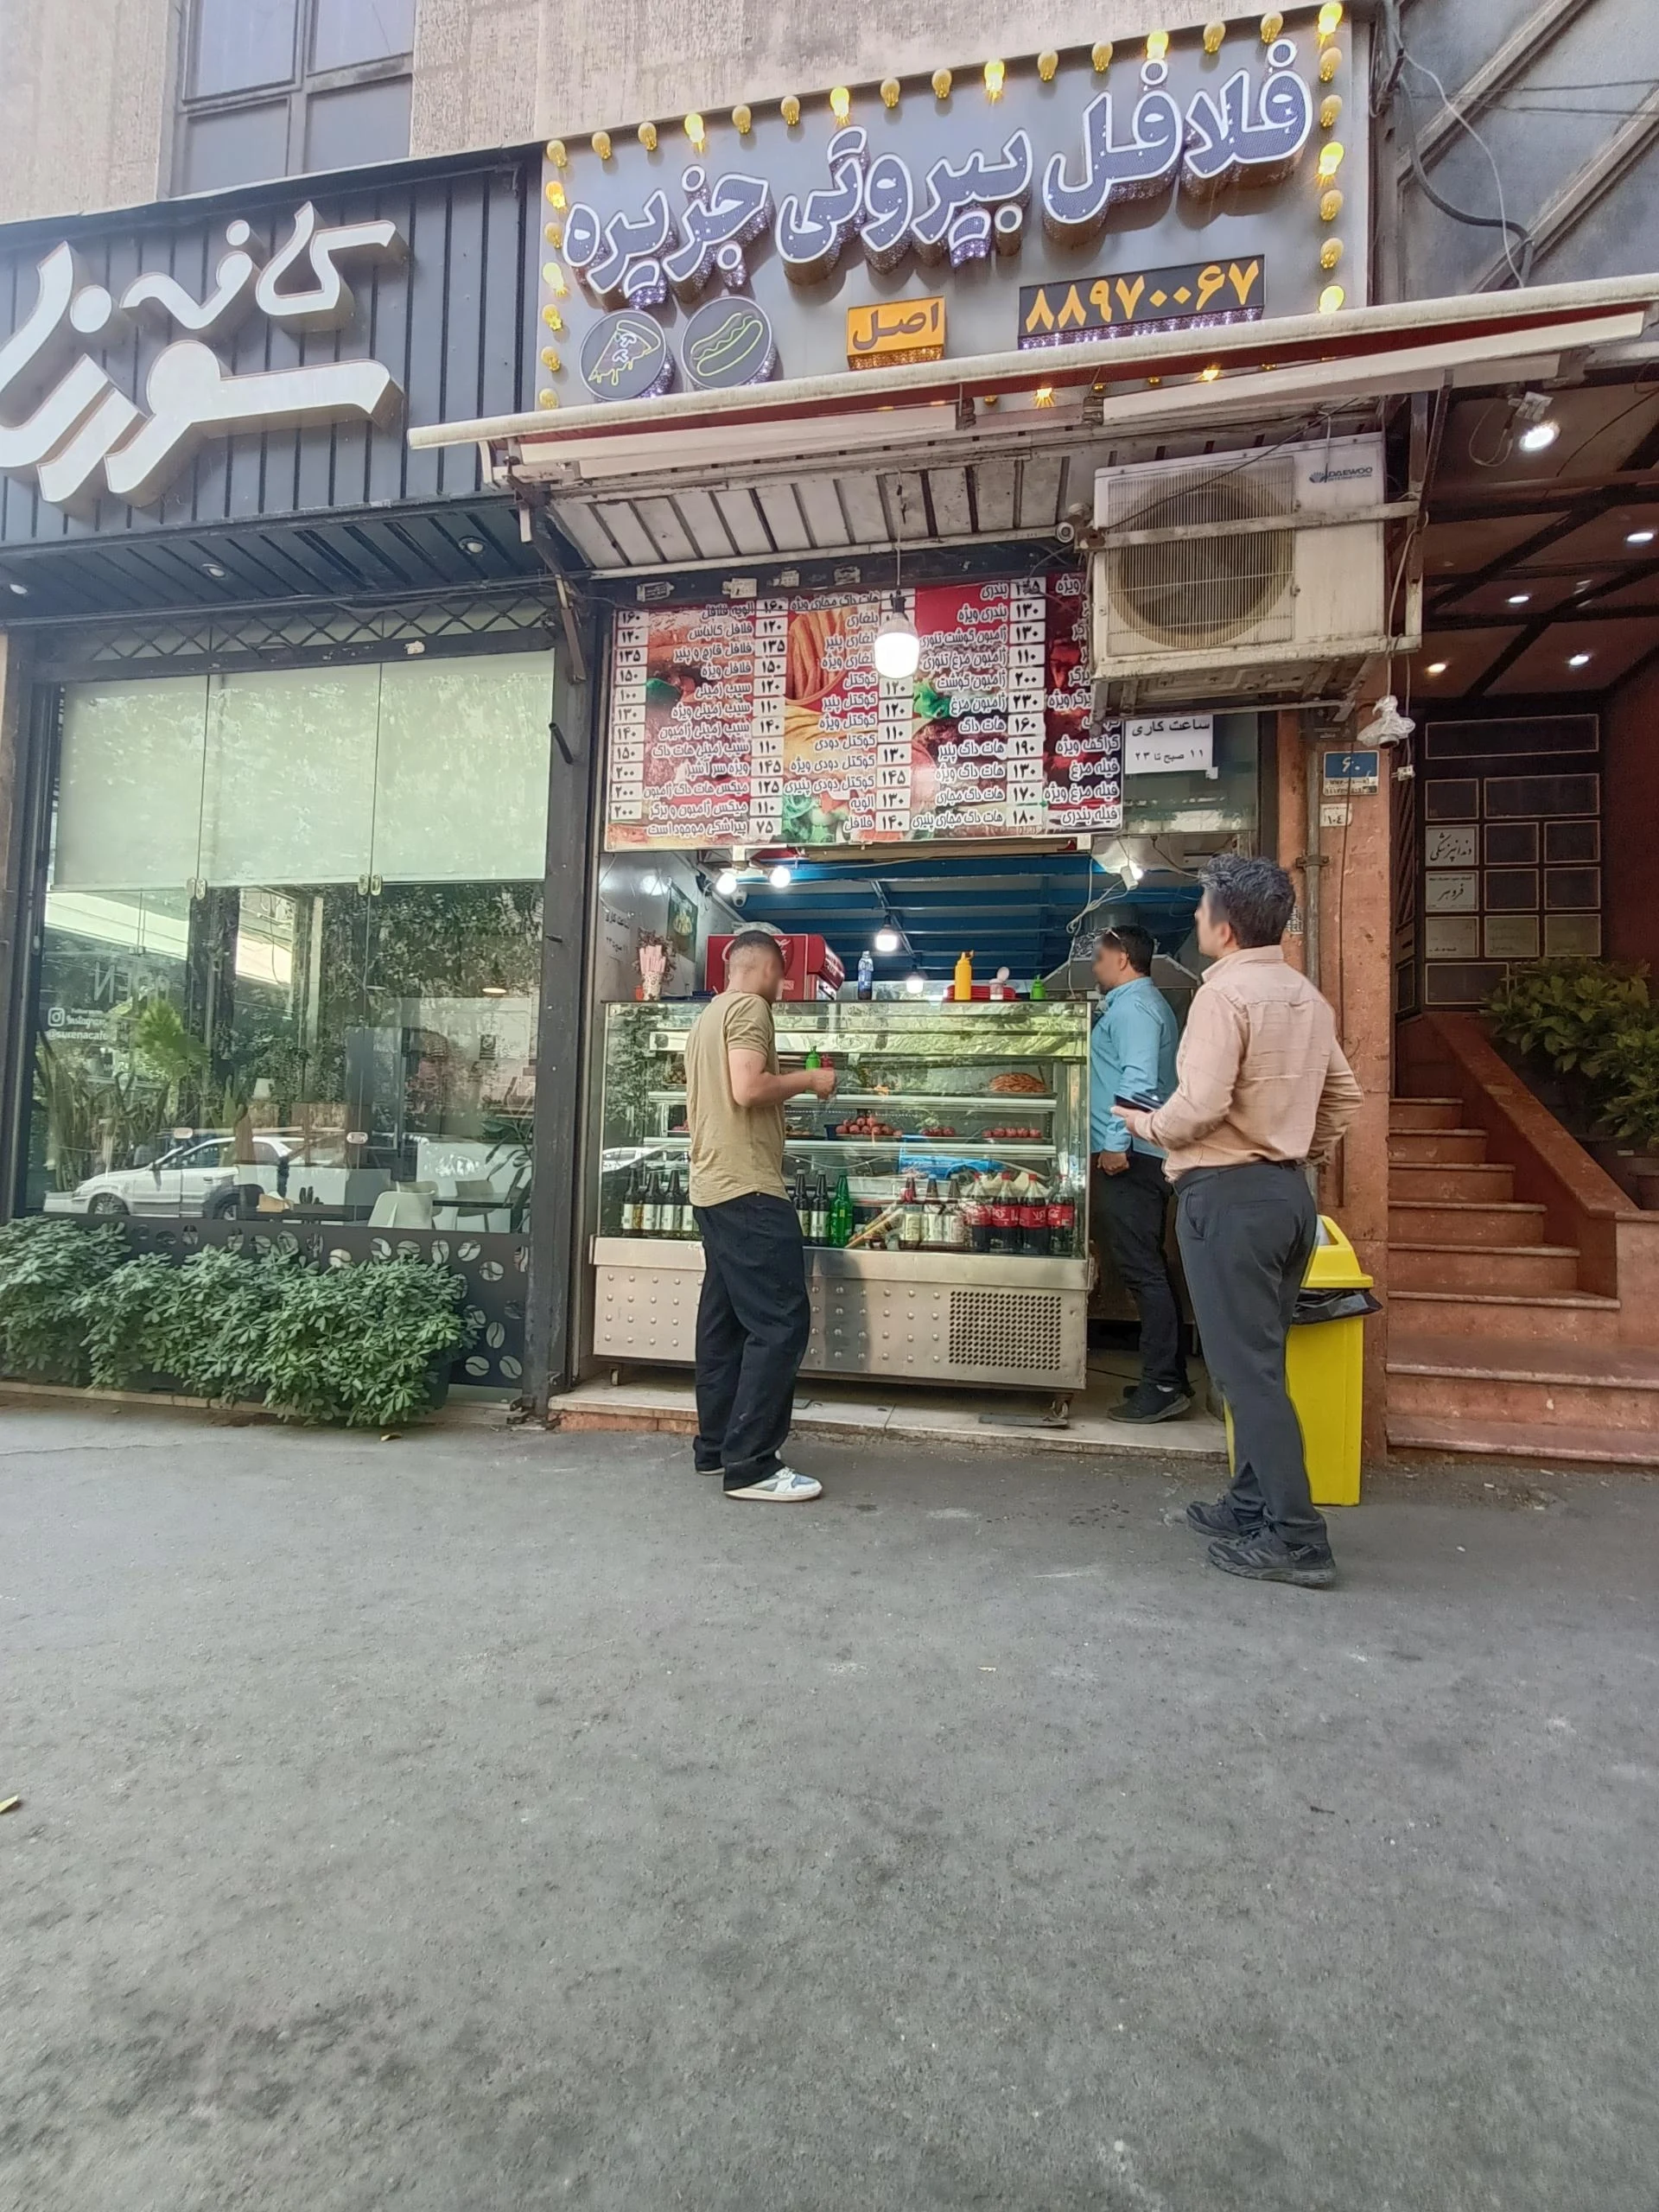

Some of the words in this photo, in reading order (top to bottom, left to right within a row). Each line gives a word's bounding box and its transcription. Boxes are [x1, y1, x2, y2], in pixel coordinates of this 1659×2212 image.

[1044, 39, 1312, 224] فلافل
[777, 127, 1032, 264] بیروتی
[563, 165, 768, 301] جزیره
[1025, 260, 1259, 329] ۸۸۹۷۰۰۶۷
[853, 302, 940, 351] اصل
[982, 583, 1007, 600] بندری
[1058, 577, 1079, 595] ویژه
[764, 601, 783, 613] ۱۶۰
[958, 605, 978, 622] ویژه
[982, 606, 1007, 621] بندری
[1016, 605, 1038, 618] ۱۳۰
[621, 613, 640, 624] ۱۶۰
[847, 613, 878, 627] بلغاری
[690, 626, 722, 639] کالباس
[727, 624, 753, 637] فلافل
[763, 621, 782, 633] ۱۲۰
[977, 625, 1006, 643] ژامبون
[1016, 627, 1038, 640] ۱۳۰
[621, 632, 639, 642] ۱۲۰
[826, 636, 842, 651] پنیر
[945, 628, 974, 645] گوشت
[694, 649, 699, 658] و
[702, 645, 721, 658] قارچ
[726, 645, 752, 657] فلافل
[763, 641, 785, 653] ۱۳۵
[620, 650, 641, 662] ۱۳۵
[675, 649, 690, 663] پنیر
[952, 653, 970, 670] مرغ
[974, 648, 1006, 667] ژامبون
[1018, 649, 1035, 663] ۱۱۰
[702, 664, 721, 677] ویژه
[724, 664, 751, 677] فلافل
[762, 661, 780, 673] ۱۵۰
[823, 656, 842, 671] ویژه
[620, 670, 638, 682] ۱۵۰
[844, 673, 876, 689] کوکتل
[937, 673, 969, 689] گوشت
[974, 671, 1005, 690] ژامبون
[1015, 672, 1036, 685] ۲۰۰
[695, 683, 723, 698] زمینی
[726, 683, 750, 696] سیب
[761, 682, 779, 693] ۱۲۰
[887, 682, 905, 695] ۱۲۰
[620, 689, 636, 701] ۱۰۰
[843, 694, 876, 709] کوکتل
[1048, 690, 1069, 708] ویژه
[725, 702, 750, 716] سیب
[761, 701, 777, 714] ۱۱۰
[823, 698, 840, 712] پنیر
[950, 697, 969, 715] مرغ
[973, 694, 1006, 712] ژامبون
[1014, 696, 1037, 709] ۲۳۰
[618, 708, 637, 721] ۱۳۰
[673, 702, 691, 720] ویژه
[695, 702, 721, 718] زمینی
[886, 705, 904, 717] ۱۲۰
[725, 722, 749, 735] سیب
[760, 721, 779, 734] ۱۴۰
[820, 714, 840, 730] ویژه
[843, 715, 875, 729] کوکتل
[982, 717, 1006, 731] هات
[1014, 718, 1036, 732] ۱۶۰
[1133, 721, 1164, 736] کاری
[1169, 720, 1210, 731] ساعت
[617, 728, 636, 740] ۱۴۰
[659, 722, 691, 740] ژامبون
[694, 724, 721, 738] زمینی
[886, 727, 903, 740] ۱۱۰
[760, 741, 776, 754] ۱۱۰
[815, 740, 839, 751] دودی
[842, 734, 875, 749] کوکتل
[982, 740, 1004, 753] هات
[1015, 741, 1034, 755] ۱۹۰
[1057, 738, 1078, 754] ویژه
[1083, 736, 1119, 750] کراکف
[617, 747, 635, 760] ۱۵۰
[673, 745, 694, 755] هات
[696, 743, 722, 760] زمینی
[725, 743, 749, 755] سیب
[883, 750, 904, 762] ۱۳۰
[1135, 752, 1150, 760] ۲۳
[1154, 752, 1161, 760] تا
[791, 756, 810, 772] ویژه
[842, 755, 874, 770] کوکتل
[1164, 754, 1184, 763] صبح
[616, 766, 634, 779] ۲۰۰
[729, 760, 748, 775] ویژه
[760, 760, 780, 773] ۱۴۵
[815, 760, 838, 772] دودی
[982, 763, 1003, 776] هات
[1014, 764, 1035, 779] ۱۳۰
[1071, 763, 1091, 780] مرغ
[1096, 761, 1119, 777] فیله
[883, 771, 906, 784] ۱۴۵
[936, 765, 955, 782] ویژه
[694, 785, 712, 795] هات
[716, 783, 747, 797] میکس
[759, 781, 779, 793] ۱۲۵
[785, 780, 810, 795] پنیری
[814, 780, 838, 792] دودی
[842, 777, 874, 791] کوکتل
[1096, 784, 1118, 798] فیله
[615, 787, 633, 798] ۲۰۰
[938, 790, 962, 804] مجاری
[984, 786, 1003, 799] هات
[1014, 786, 1035, 801] ۱۷۰
[1046, 785, 1067, 803] ویژه
[1070, 785, 1090, 803] مرغ
[758, 802, 774, 813] ۱۱۰
[851, 796, 874, 811] الویه
[883, 794, 904, 807] ۱۳۰
[614, 805, 632, 817] ۲۰۰
[650, 803, 668, 819] برگر
[679, 799, 710, 817] ژامبون
[715, 803, 747, 814] میکس
[1095, 808, 1117, 822] فیله
[883, 817, 902, 830] ۱۴۰
[983, 810, 1002, 823] هات
[1014, 810, 1034, 824] ۱۸۰
[1062, 810, 1090, 824] بندری
[649, 824, 671, 835] است
[674, 824, 702, 837] موجود
[708, 823, 747, 836] پیراشکی
[757, 821, 773, 834] ۷۵
[844, 817, 872, 832] فلافل
[1430, 833, 1471, 861] دندانپزشکی
